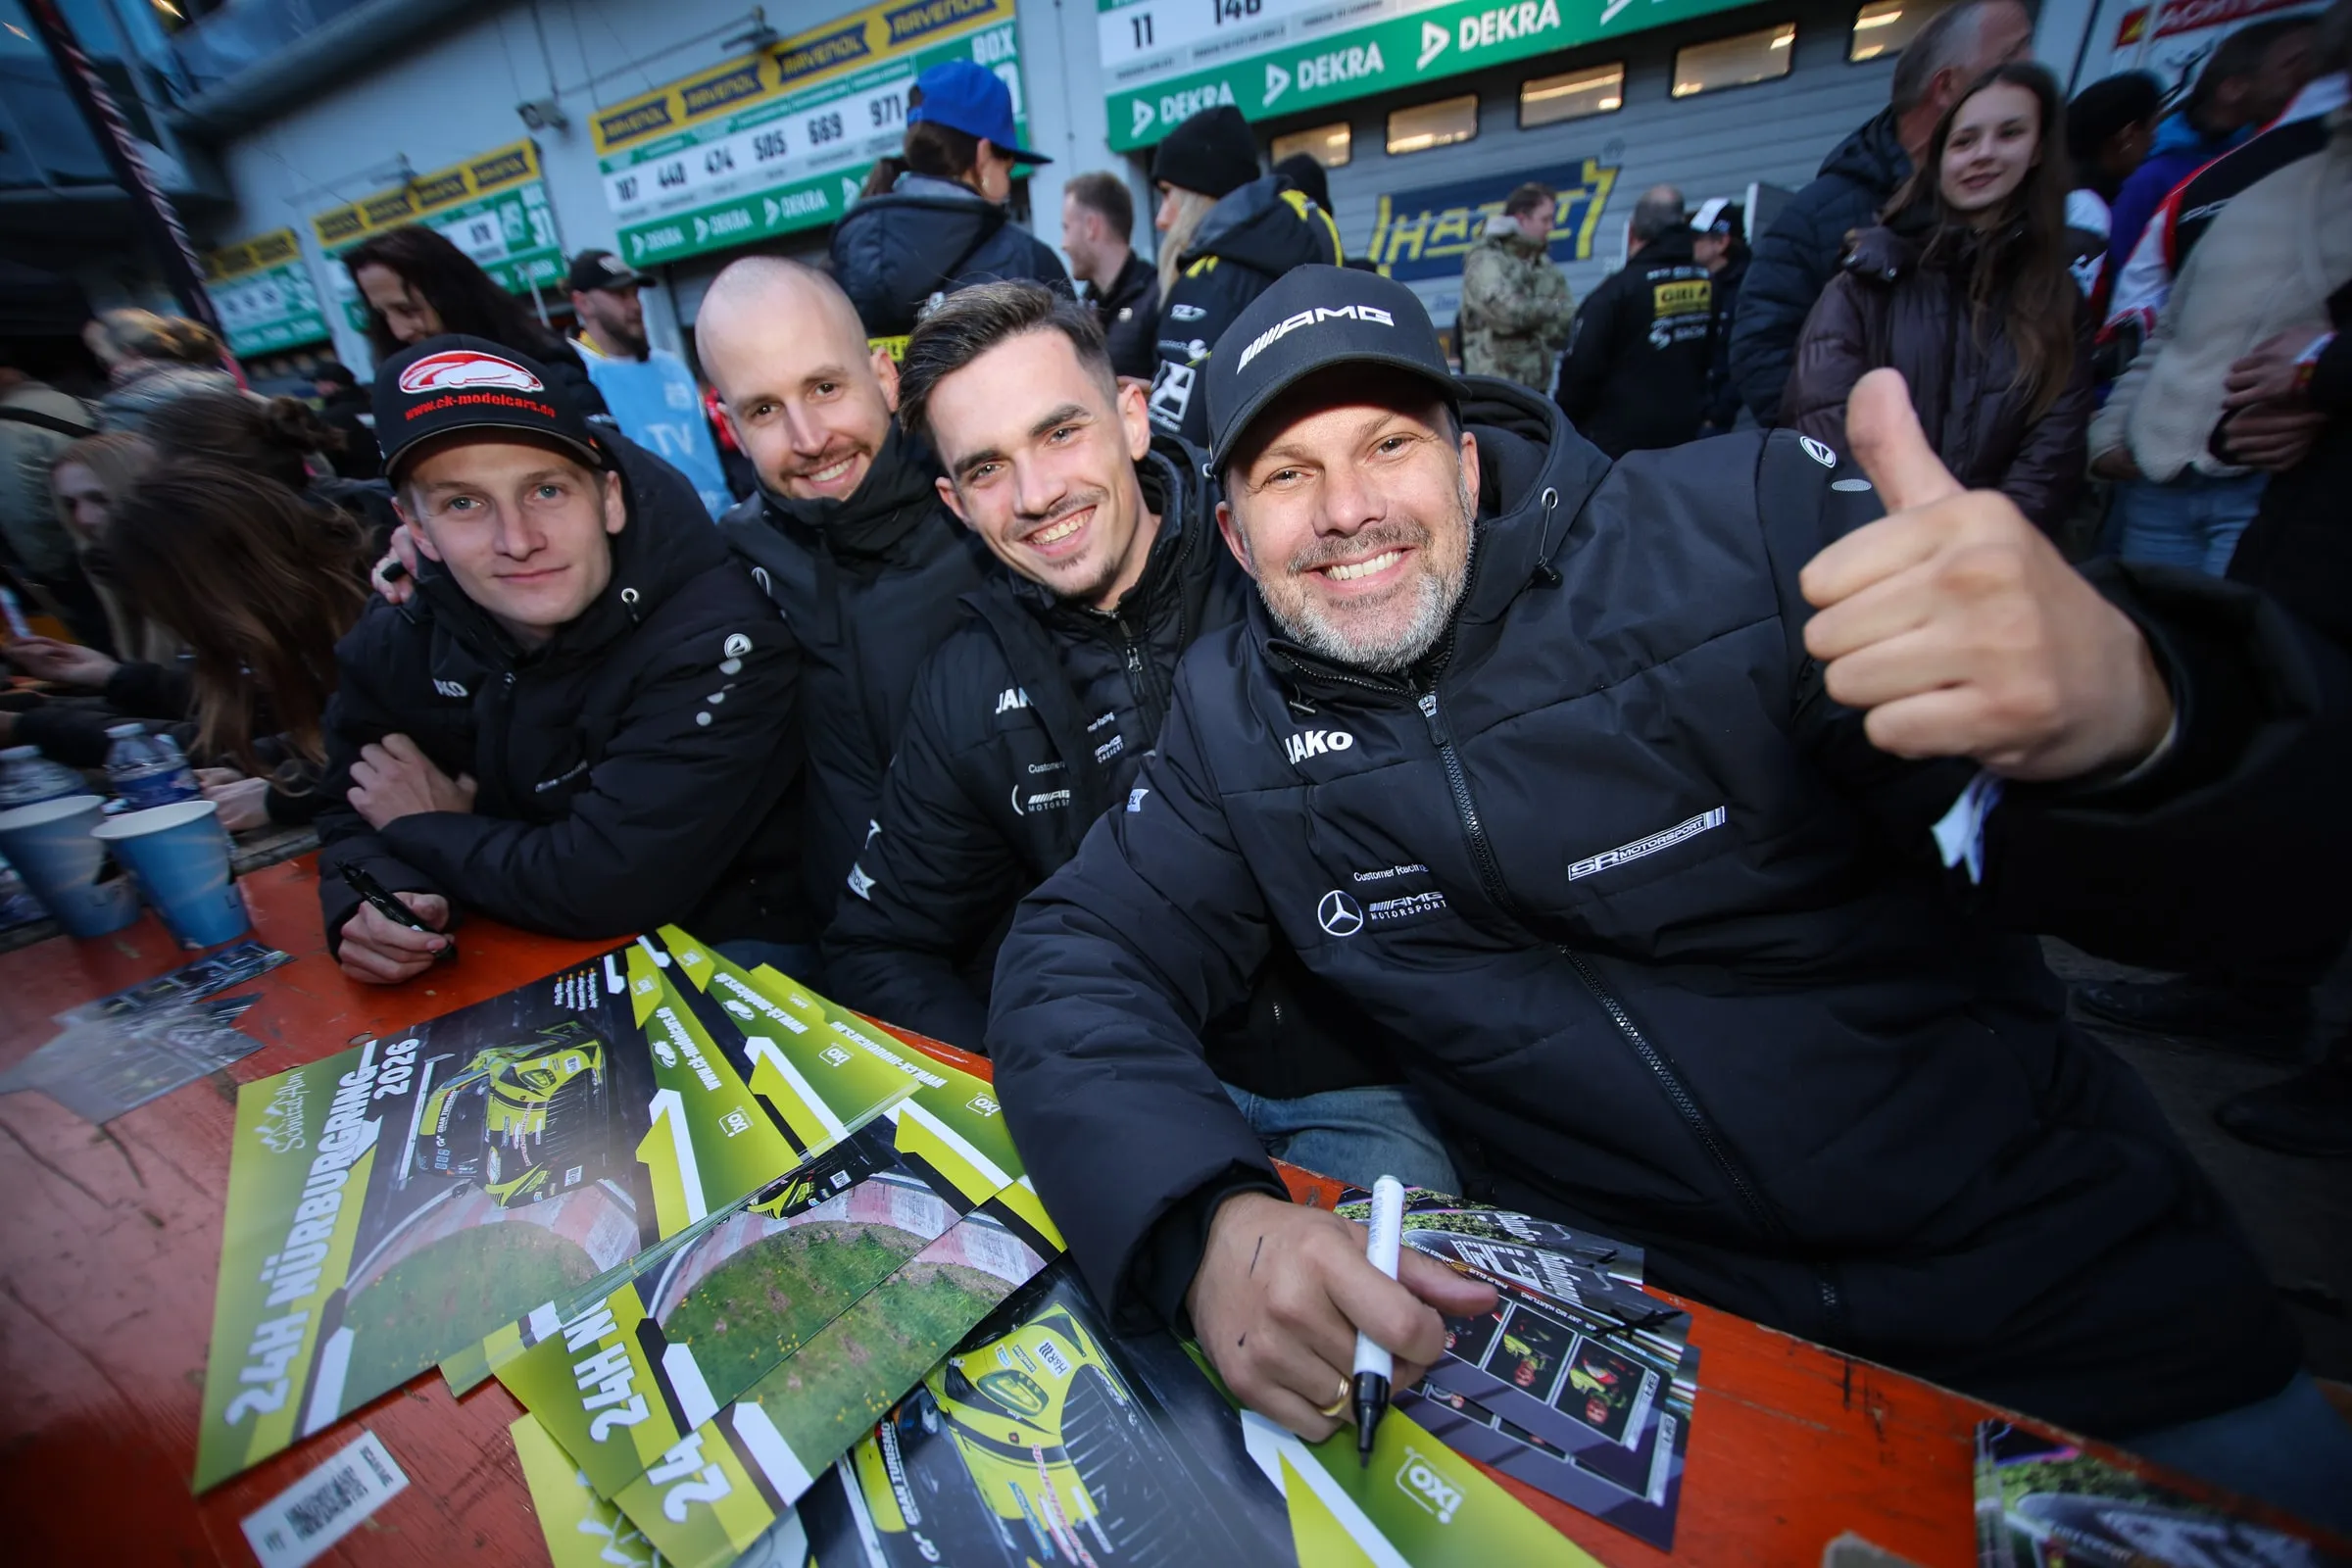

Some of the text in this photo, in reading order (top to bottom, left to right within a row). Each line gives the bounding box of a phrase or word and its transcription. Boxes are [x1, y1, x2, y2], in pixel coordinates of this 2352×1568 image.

[971, 24, 1016, 65] BOX
[1132, 14, 1154, 48] 11
[1458, 0, 1561, 52] DEKRA
[1297, 41, 1385, 91] DEKRA
[870, 94, 903, 127] 971
[1159, 80, 1236, 124] DEKRA
[405, 392, 557, 421] www.ck-modelcars.de
[1285, 729, 1353, 764] JAKO
[1571, 818, 1705, 876] SR MOTORSPORT
[1353, 865, 1395, 883] Customer
[1370, 899, 1447, 920] MOTORSPORT
[372, 1038, 420, 1102] 2026
[223, 1068, 376, 1428] 24H NÜRBURGRING
[573, 1342, 652, 1444] 24H
[881, 1422, 904, 1483] TURISMO
[647, 1431, 733, 1523] 24
